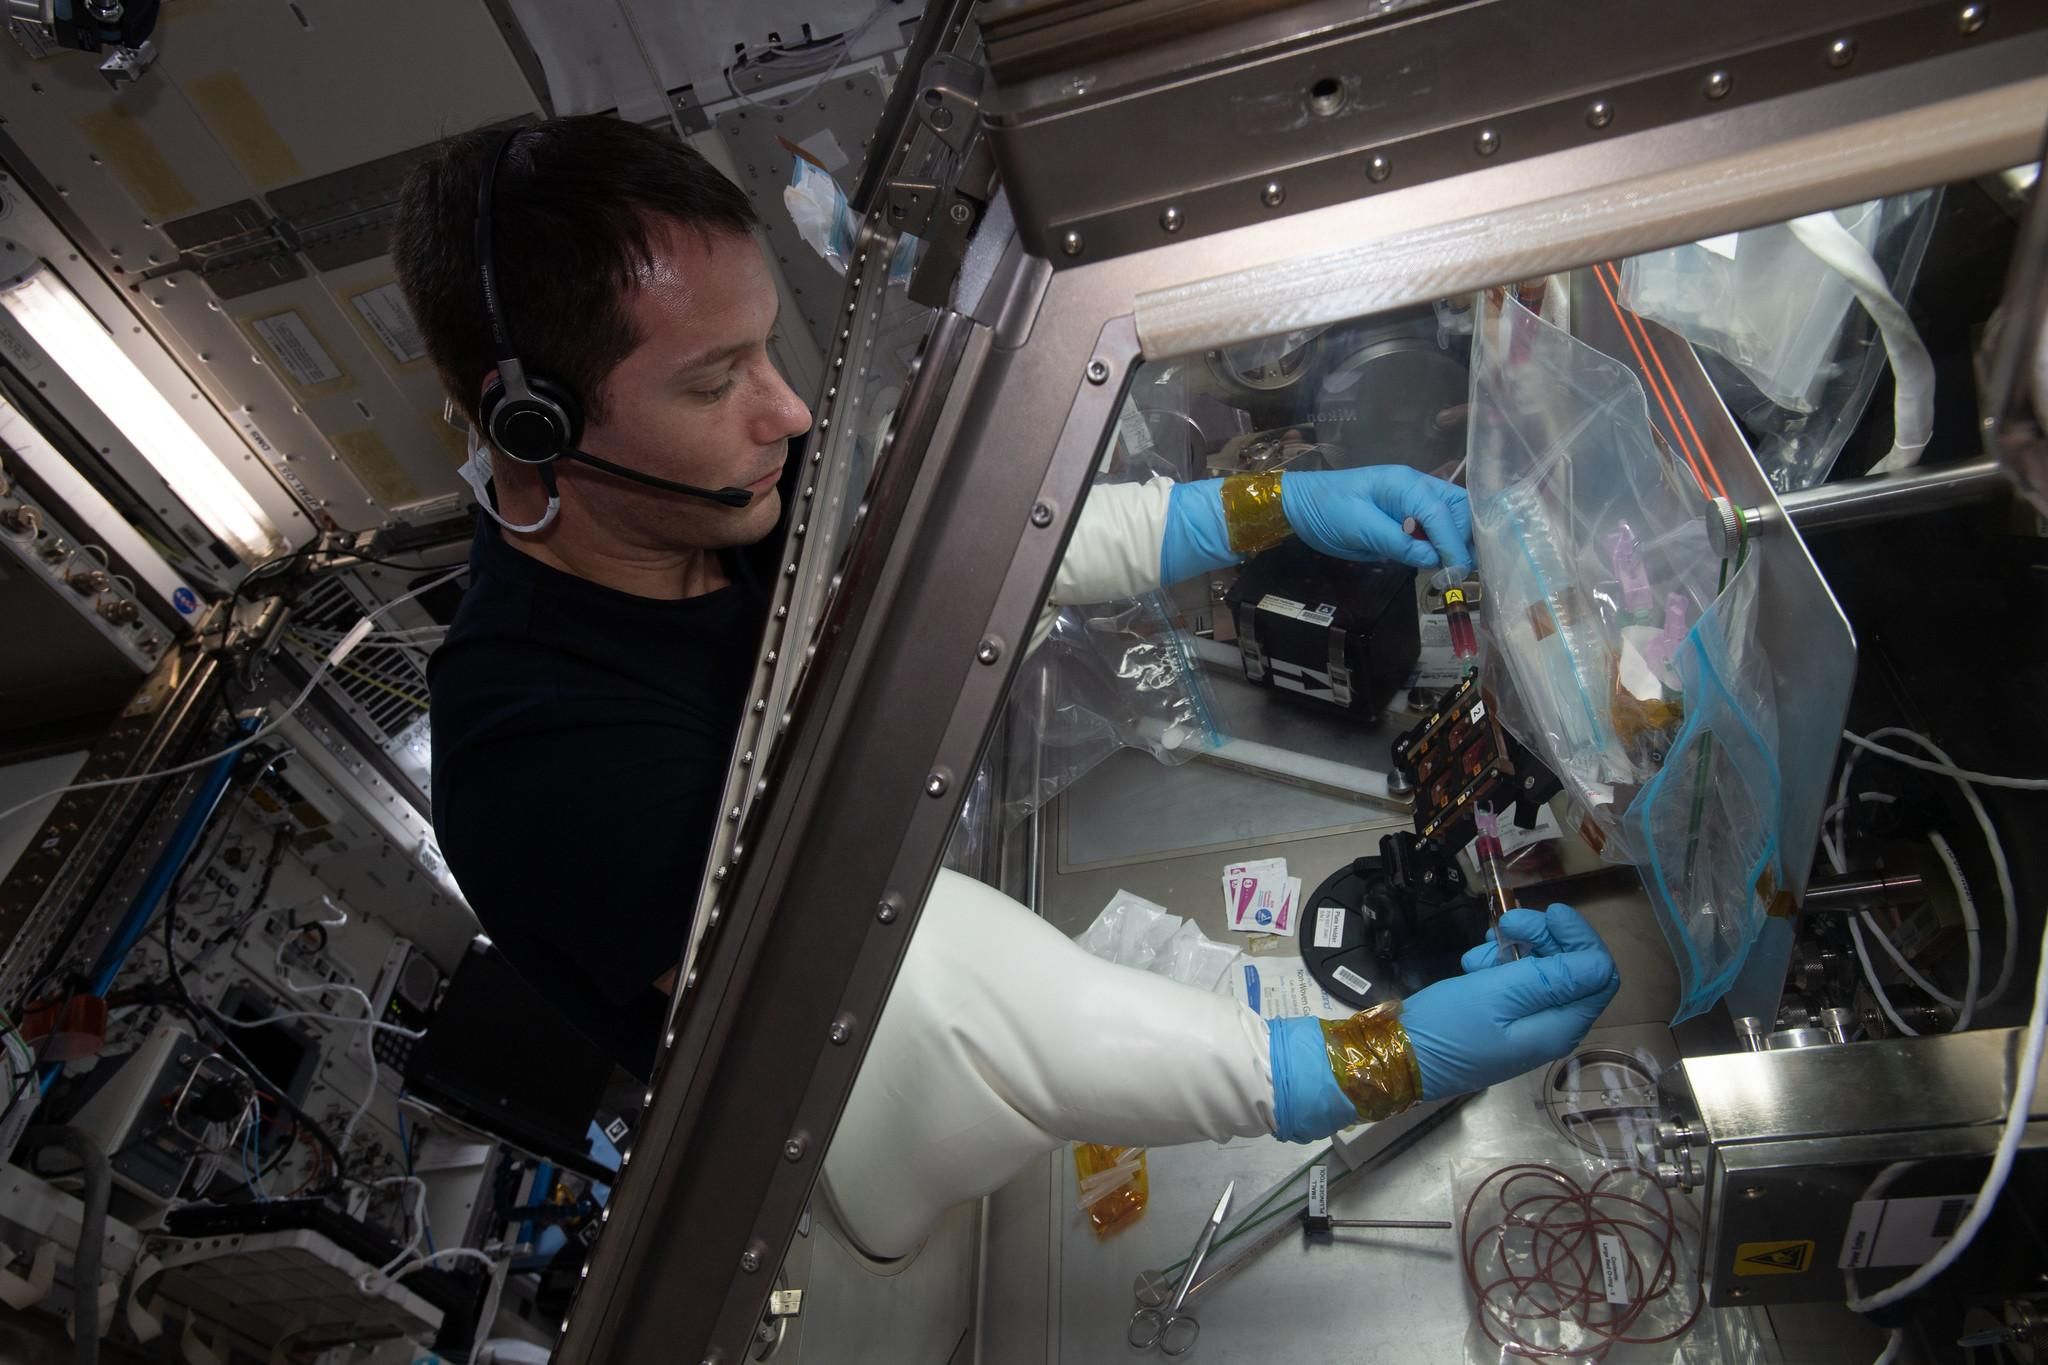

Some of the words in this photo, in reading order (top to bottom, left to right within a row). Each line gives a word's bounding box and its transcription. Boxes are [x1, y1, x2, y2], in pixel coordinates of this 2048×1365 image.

[251, 431, 271, 452] DMS
[1450, 591, 1460, 601] A
[1296, 969, 1308, 1006] Non-Woven
